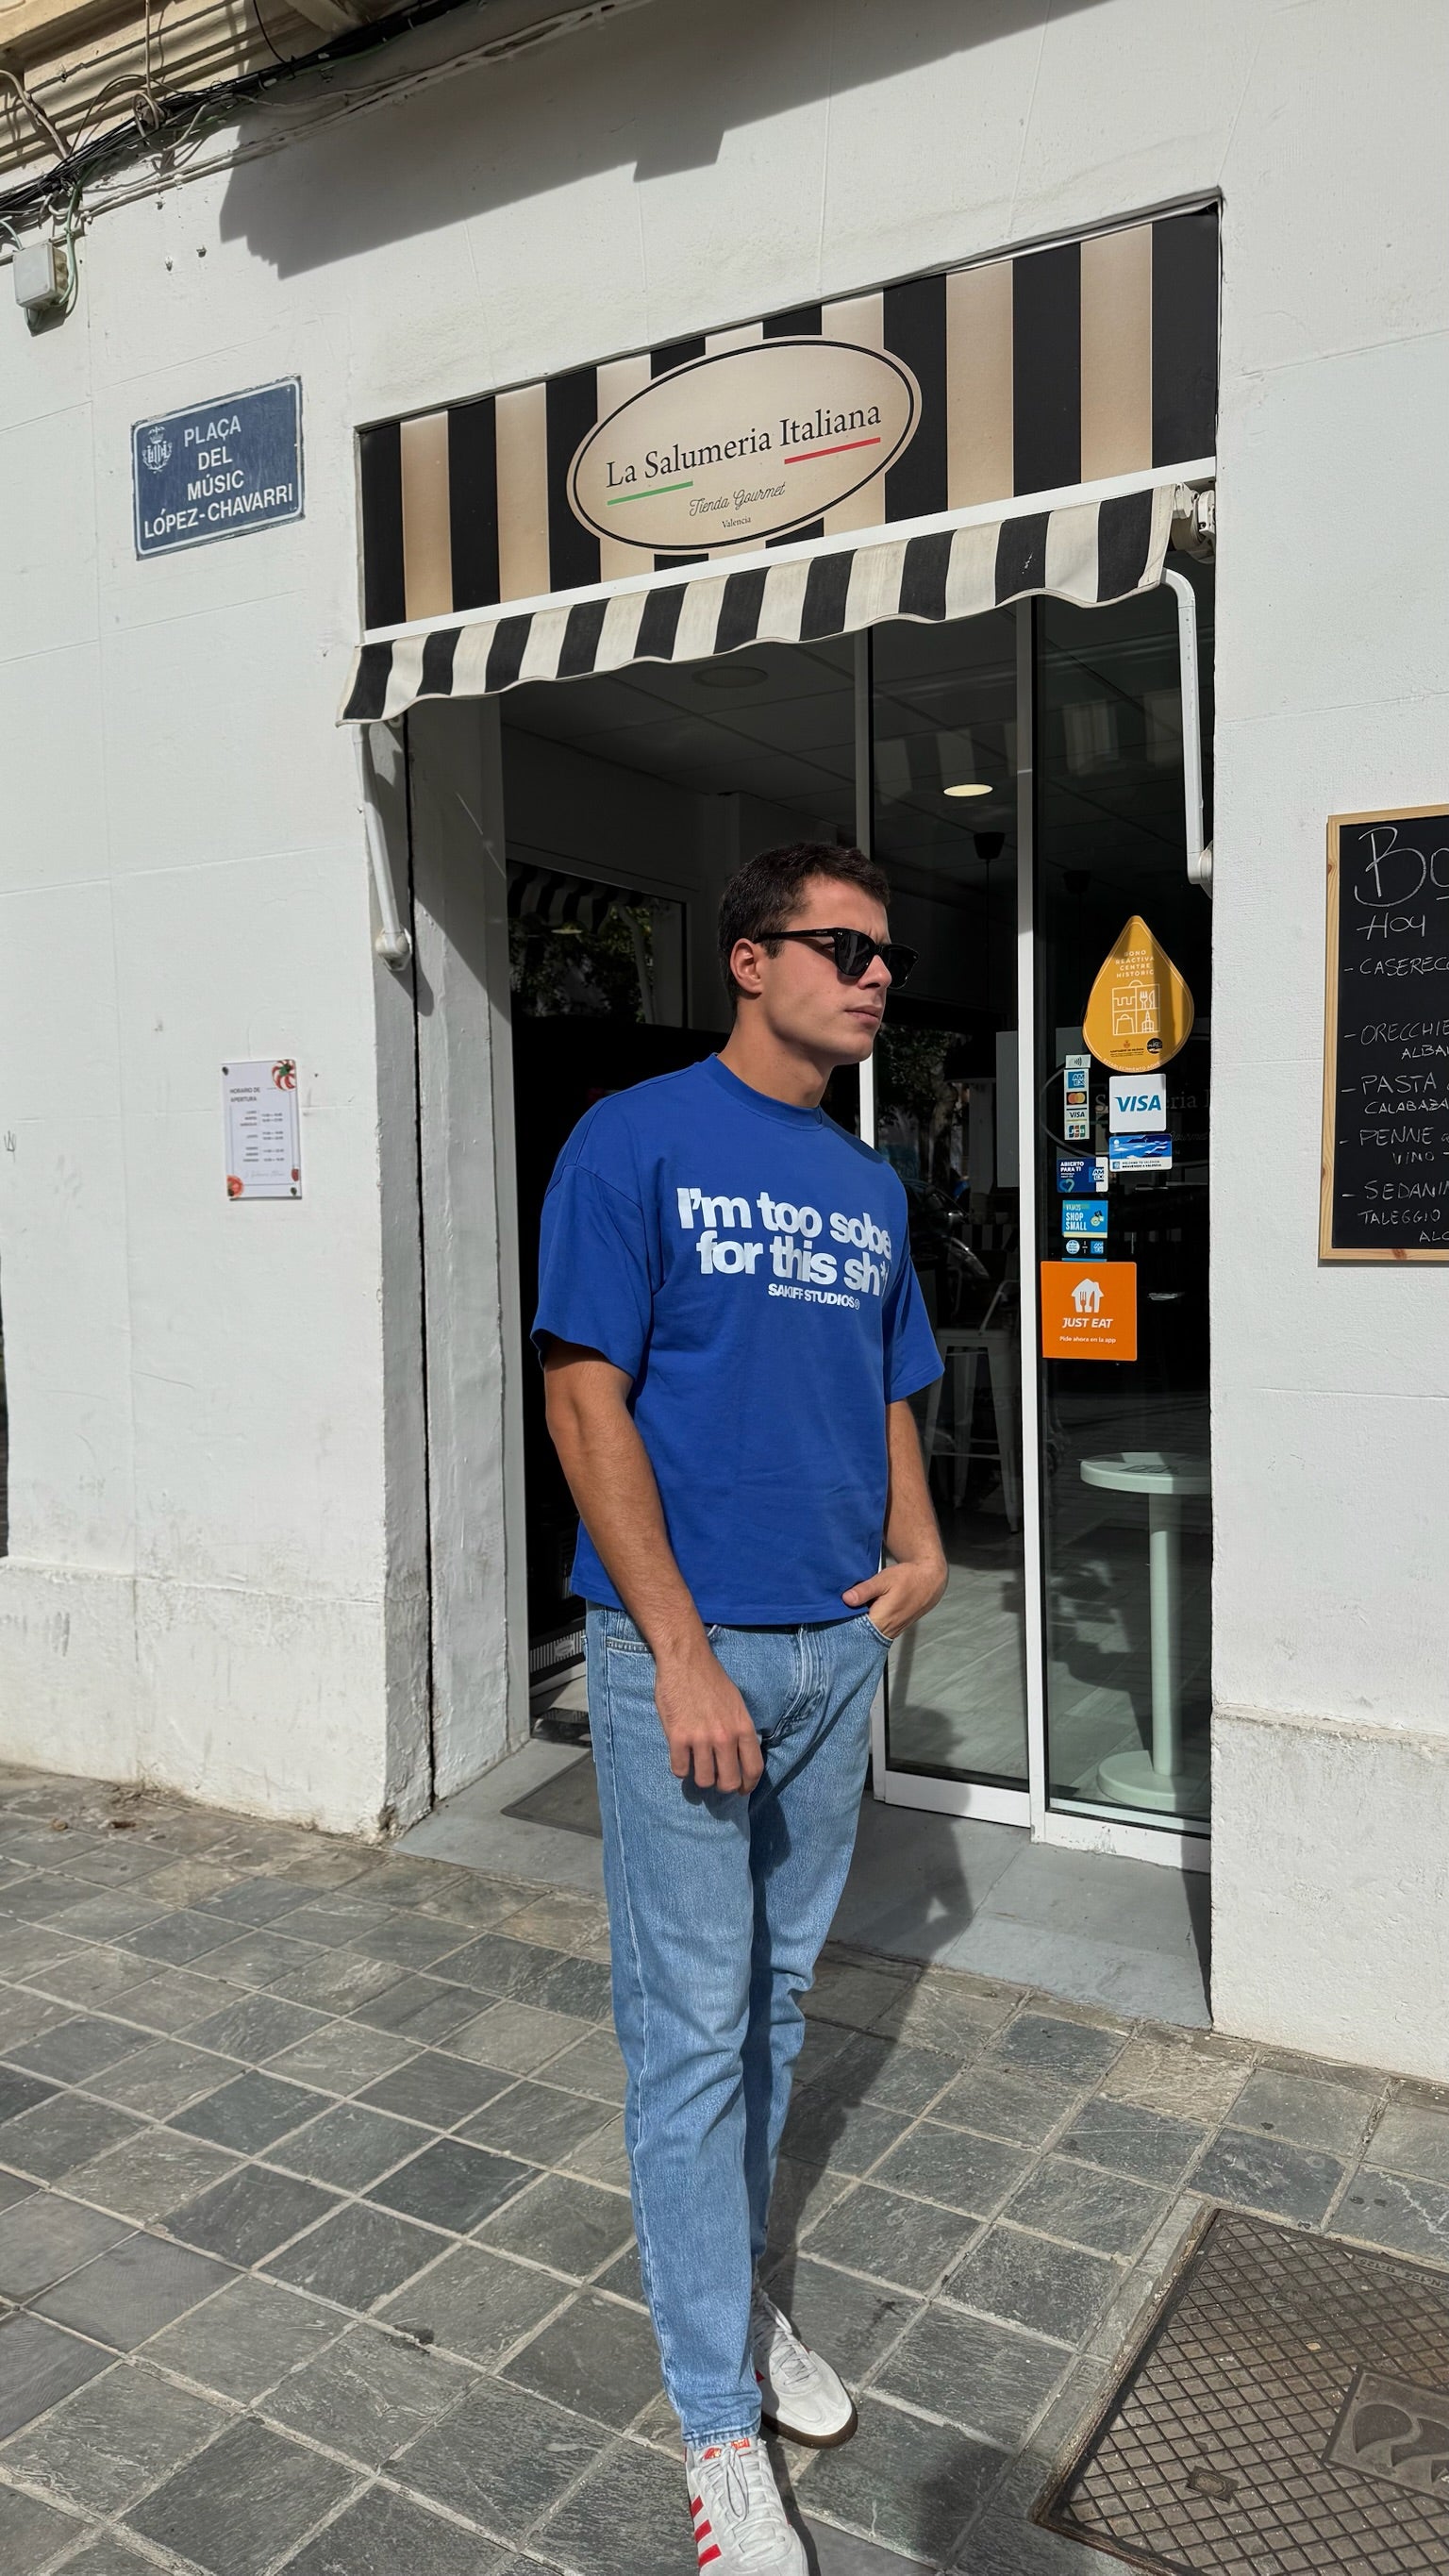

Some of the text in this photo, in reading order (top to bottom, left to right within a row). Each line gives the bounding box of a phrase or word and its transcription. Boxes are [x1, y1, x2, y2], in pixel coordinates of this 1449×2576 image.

[184, 415, 242, 447] PLAÇA
[606, 404, 882, 488] La Salumeria Italiana
[198, 446, 233, 471] DEL
[187, 470, 244, 501] MÚSIC
[689, 481, 787, 517] Tienda Gourmet
[144, 483, 293, 539] LÓPEZ-CHAVARRI
[722, 516, 752, 528] Valencia
[1359, 956, 1449, 976] CASEREC
[1360, 1072, 1437, 1095] PASTA
[1114, 1095, 1161, 1112] VISA
[1359, 1126, 1434, 1146] PENNE
[1392, 1150, 1435, 1166] VINO
[677, 1188, 892, 1261] I'm too sobe
[1065, 1212, 1084, 1221] SHOP
[1065, 1221, 1087, 1230] SMALL
[696, 1230, 763, 1274] for
[770, 1236, 838, 1285] this
[768, 1282, 804, 1299] SAKIFF
[1062, 1317, 1113, 1329] JUST EAT
